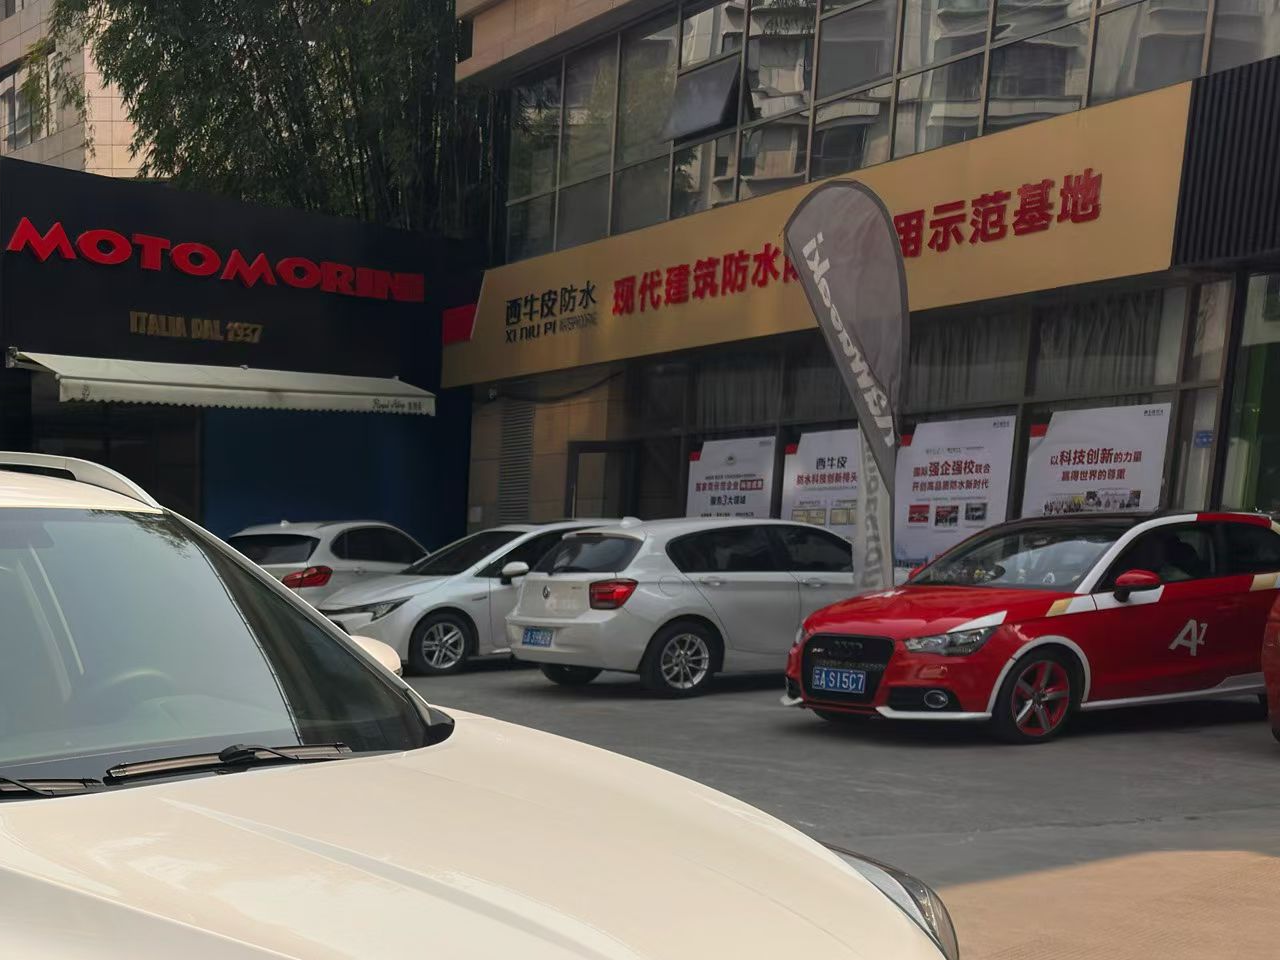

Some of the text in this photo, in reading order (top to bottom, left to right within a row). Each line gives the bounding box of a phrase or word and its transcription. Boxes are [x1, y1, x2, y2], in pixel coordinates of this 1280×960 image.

[505, 280, 597, 326] 西牛皮防水
[129, 309, 264, 344] ITALIA DAL 1937
[1050, 447, 1142, 466] 以科技创新的力量
